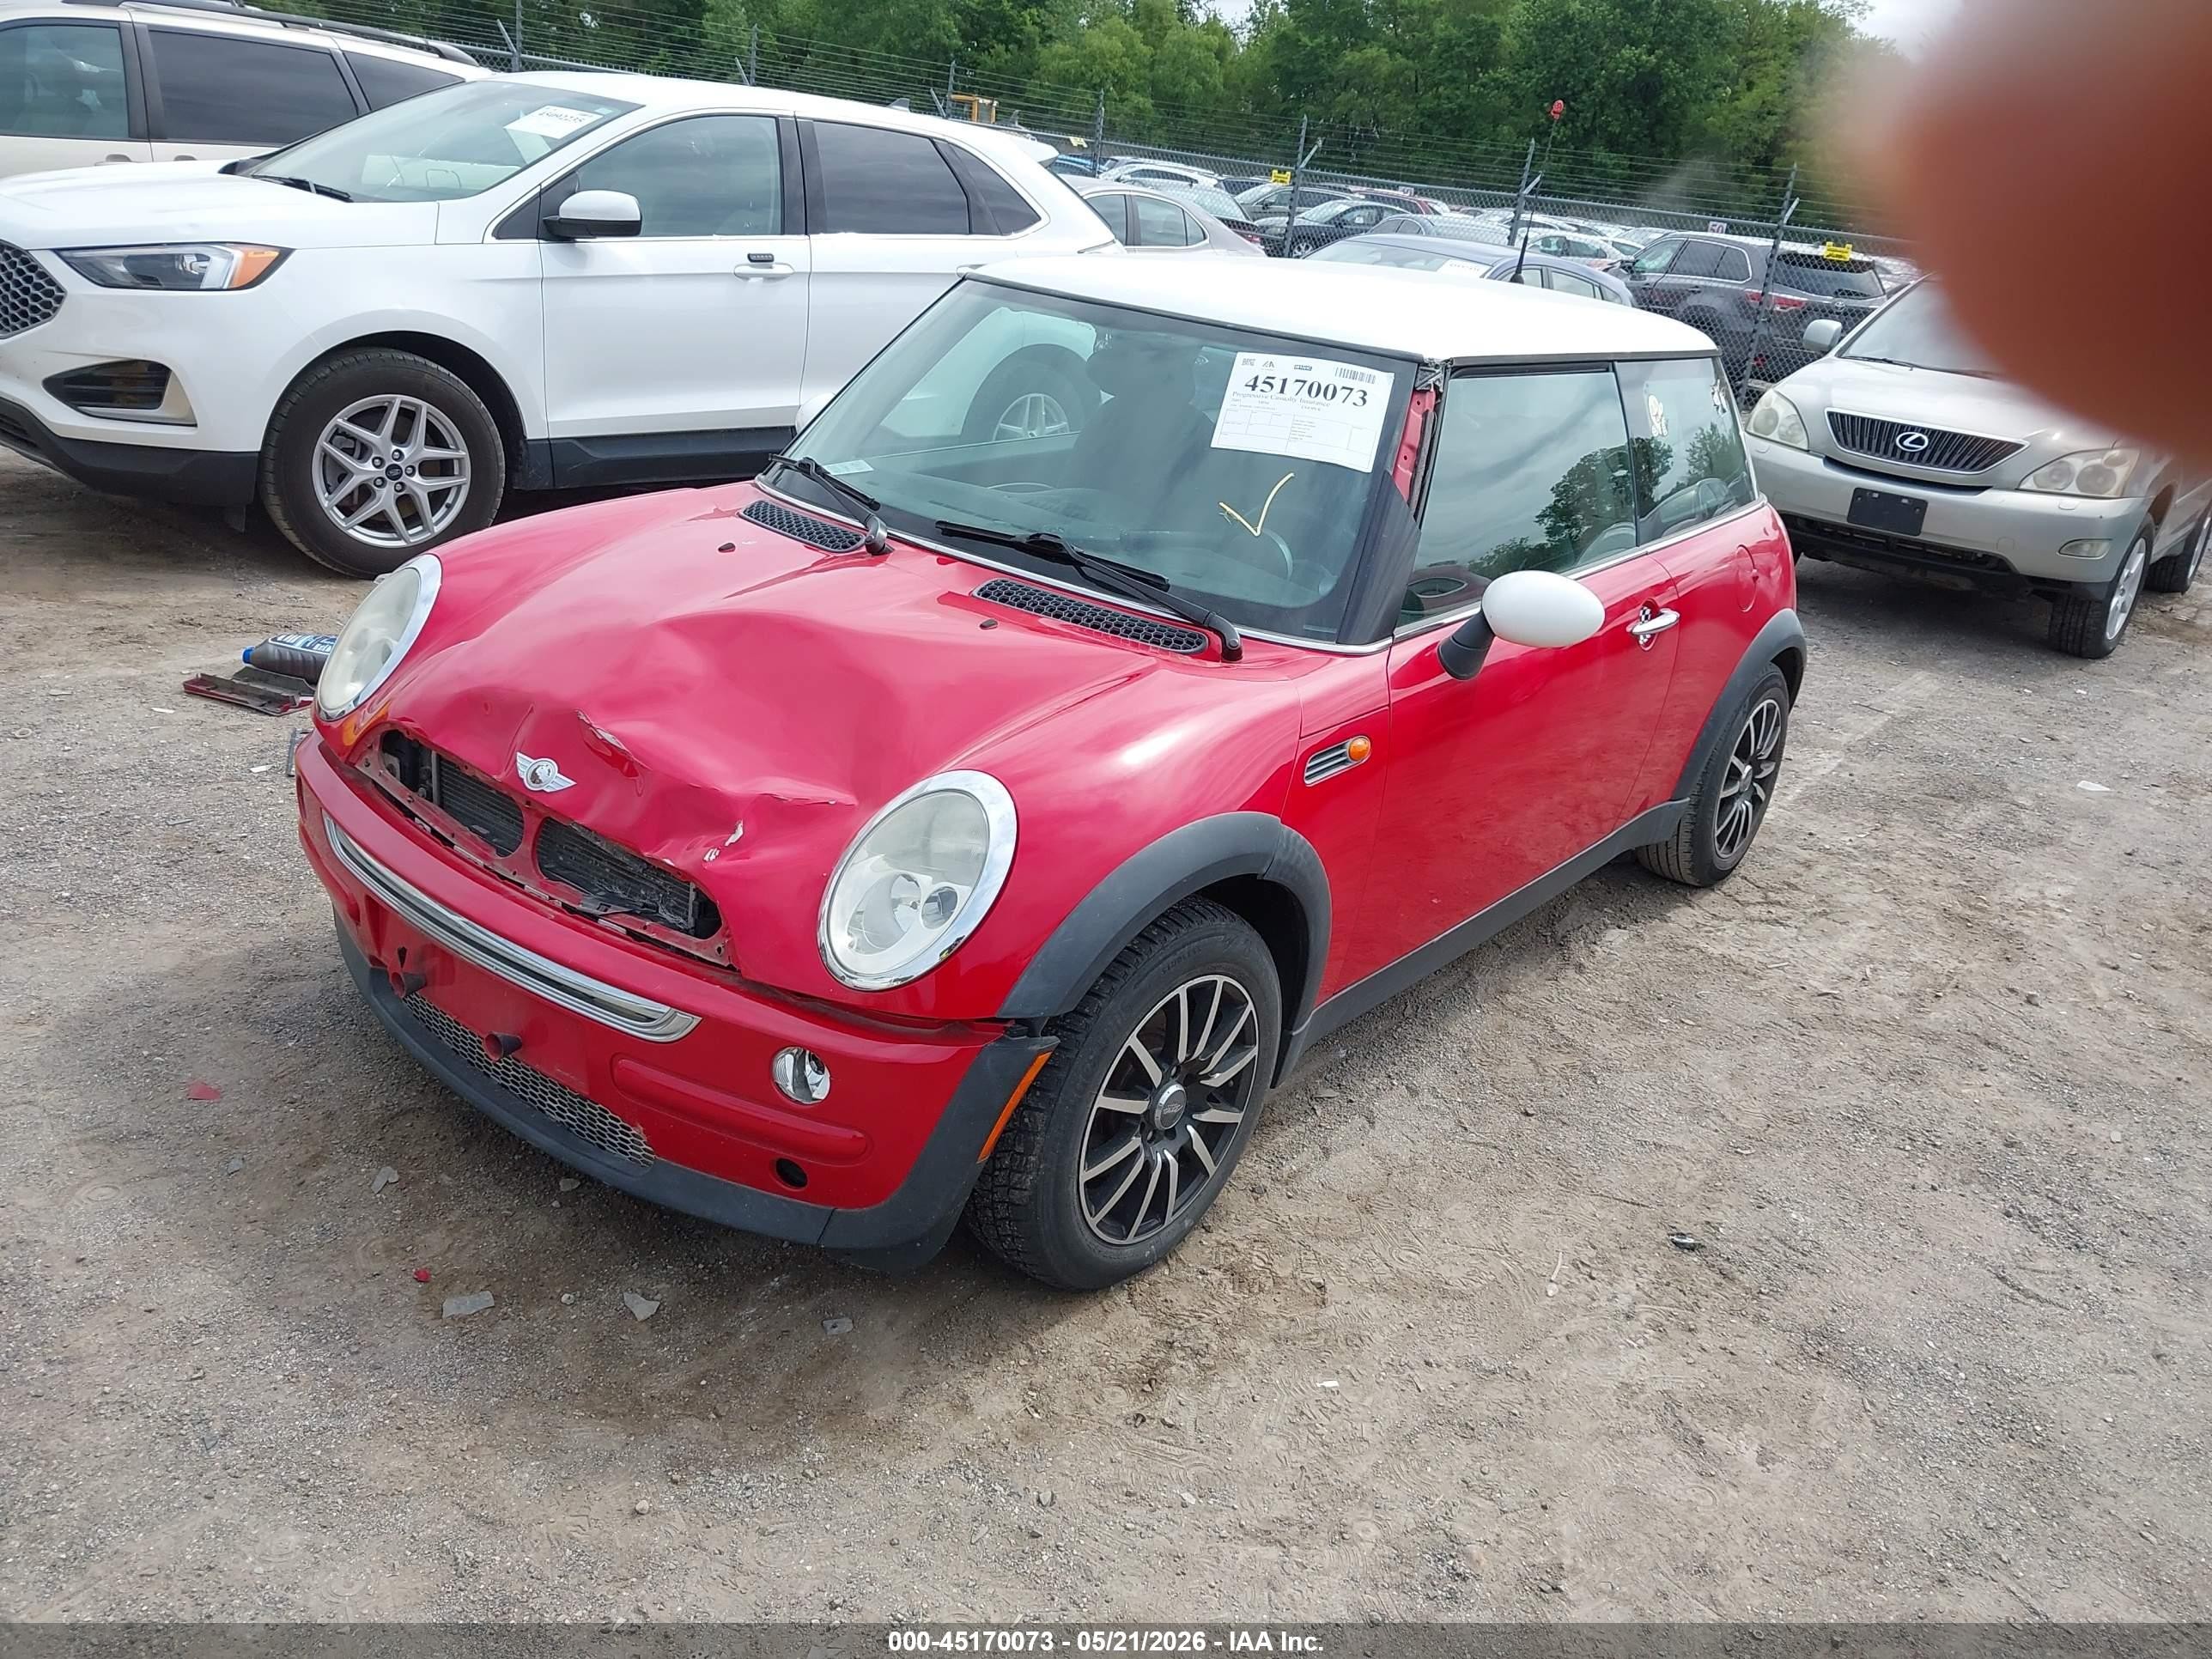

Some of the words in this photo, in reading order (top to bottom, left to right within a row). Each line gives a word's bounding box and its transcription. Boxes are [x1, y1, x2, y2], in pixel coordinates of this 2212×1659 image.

[1232, 391, 1268, 399] Progressive
[1270, 394, 1297, 403] Casualty
[1299, 398, 1331, 408] Insurance
[1243, 374, 1369, 407] 45170073
